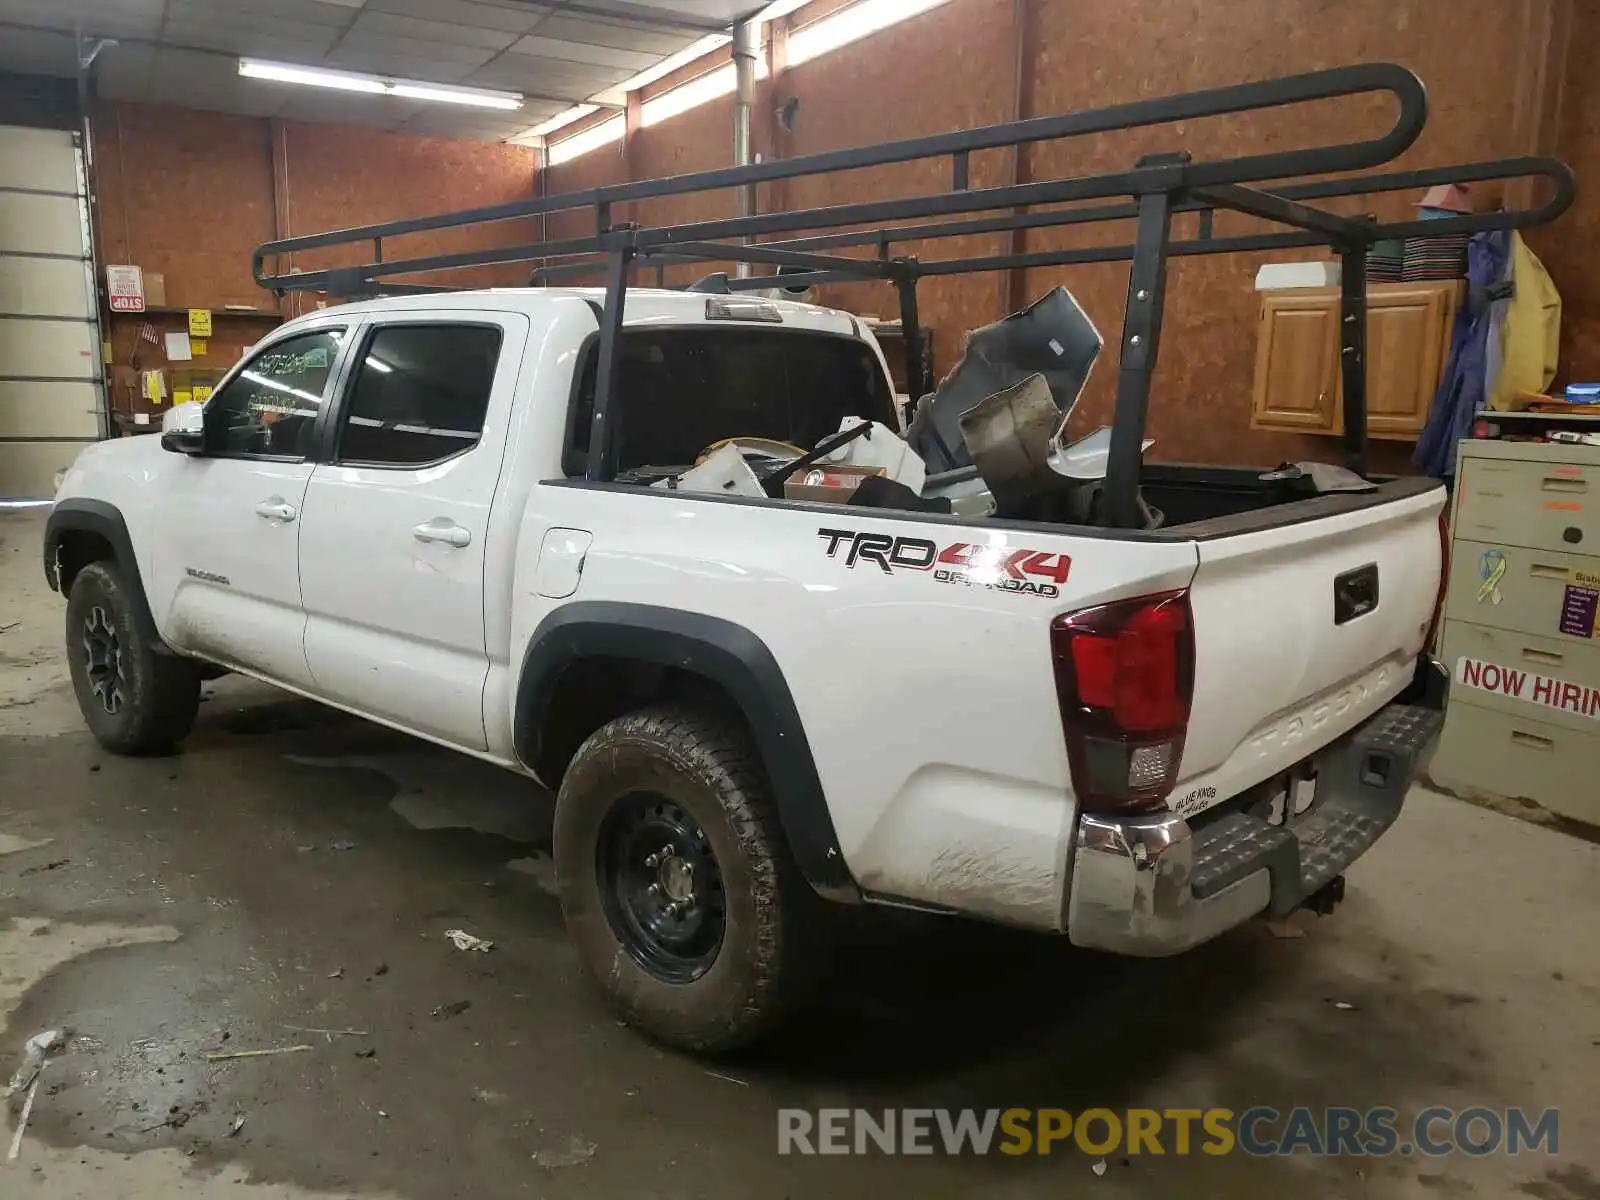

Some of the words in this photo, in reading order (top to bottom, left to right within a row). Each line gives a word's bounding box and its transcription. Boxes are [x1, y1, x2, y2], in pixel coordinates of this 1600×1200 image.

[113, 297, 142, 309] STOP
[817, 528, 938, 575] TRD
[1463, 659, 1527, 697] NOW
[1197, 787, 1217, 799] KNOB
